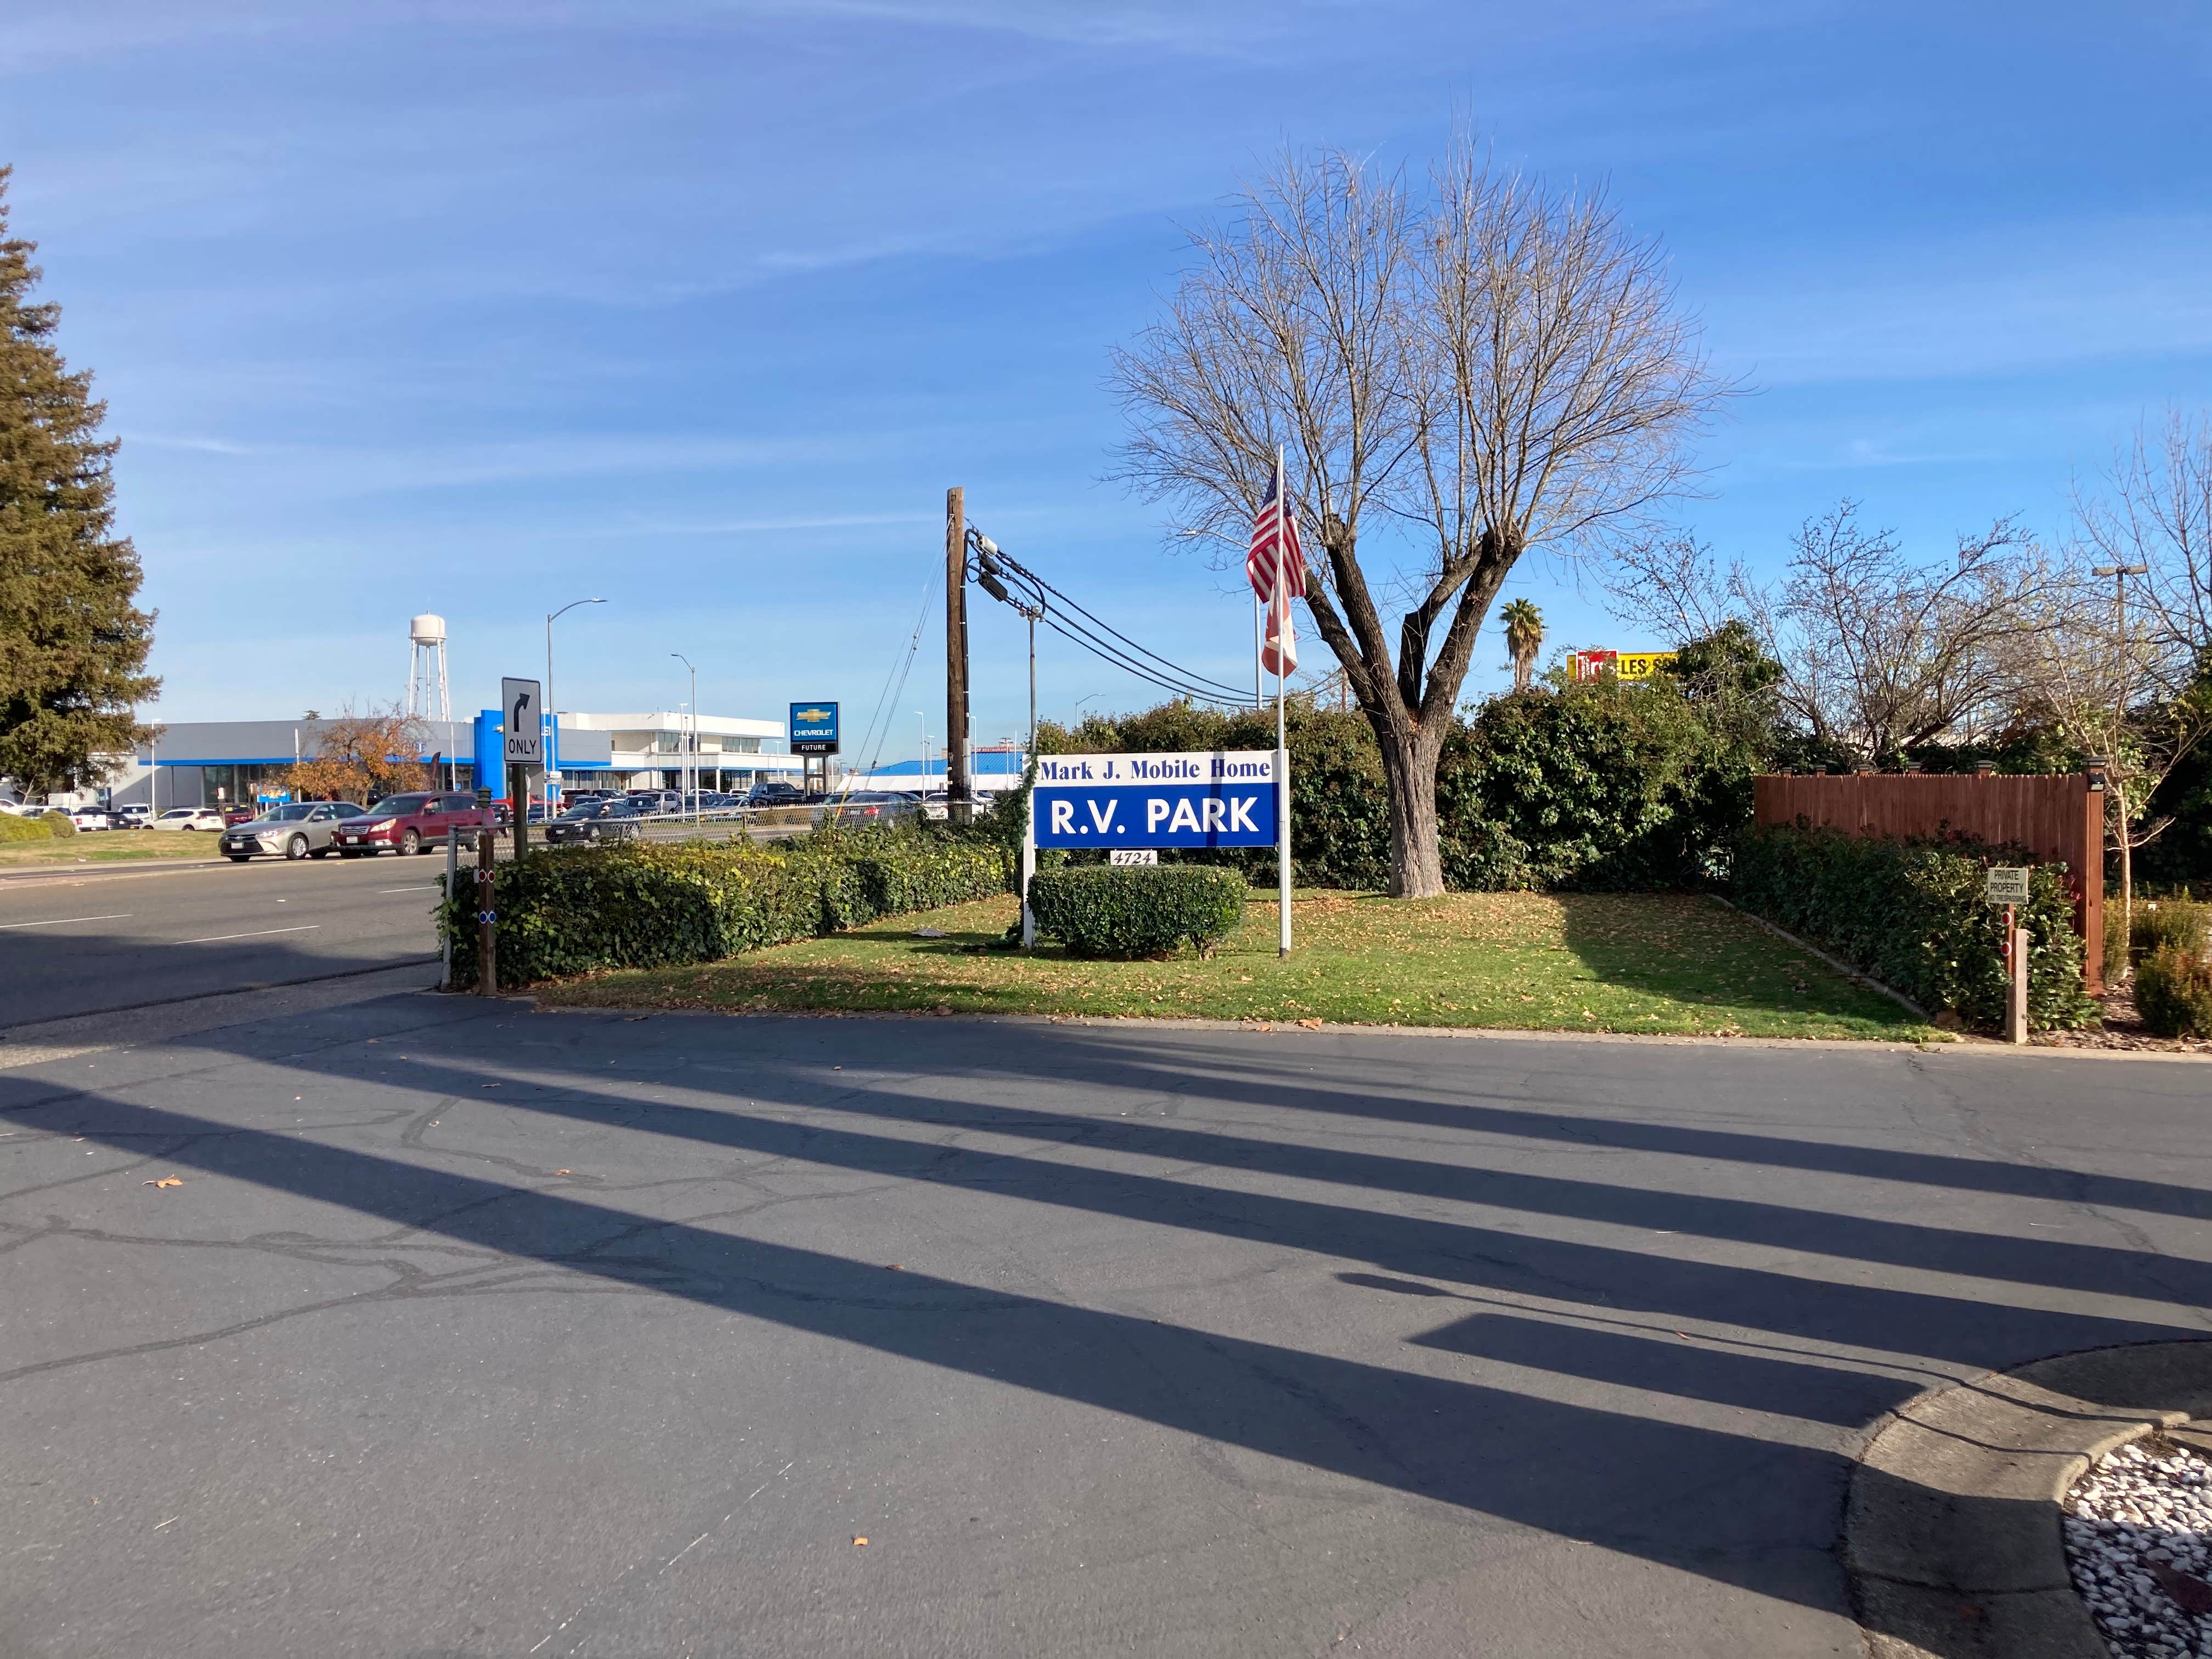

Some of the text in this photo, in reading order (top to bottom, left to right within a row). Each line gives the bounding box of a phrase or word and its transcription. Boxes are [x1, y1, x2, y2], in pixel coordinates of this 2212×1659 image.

[1621, 658, 1646, 675] LES
[509, 738, 537, 754] ONLY
[1040, 759, 1270, 780] Mark J. Mobile Home
[1051, 797, 1260, 834] R.V. PARK
[1114, 852, 1152, 865] 4724
[1994, 870, 2019, 880] PRIVATE
[1990, 882, 2023, 893] PROPERTY
